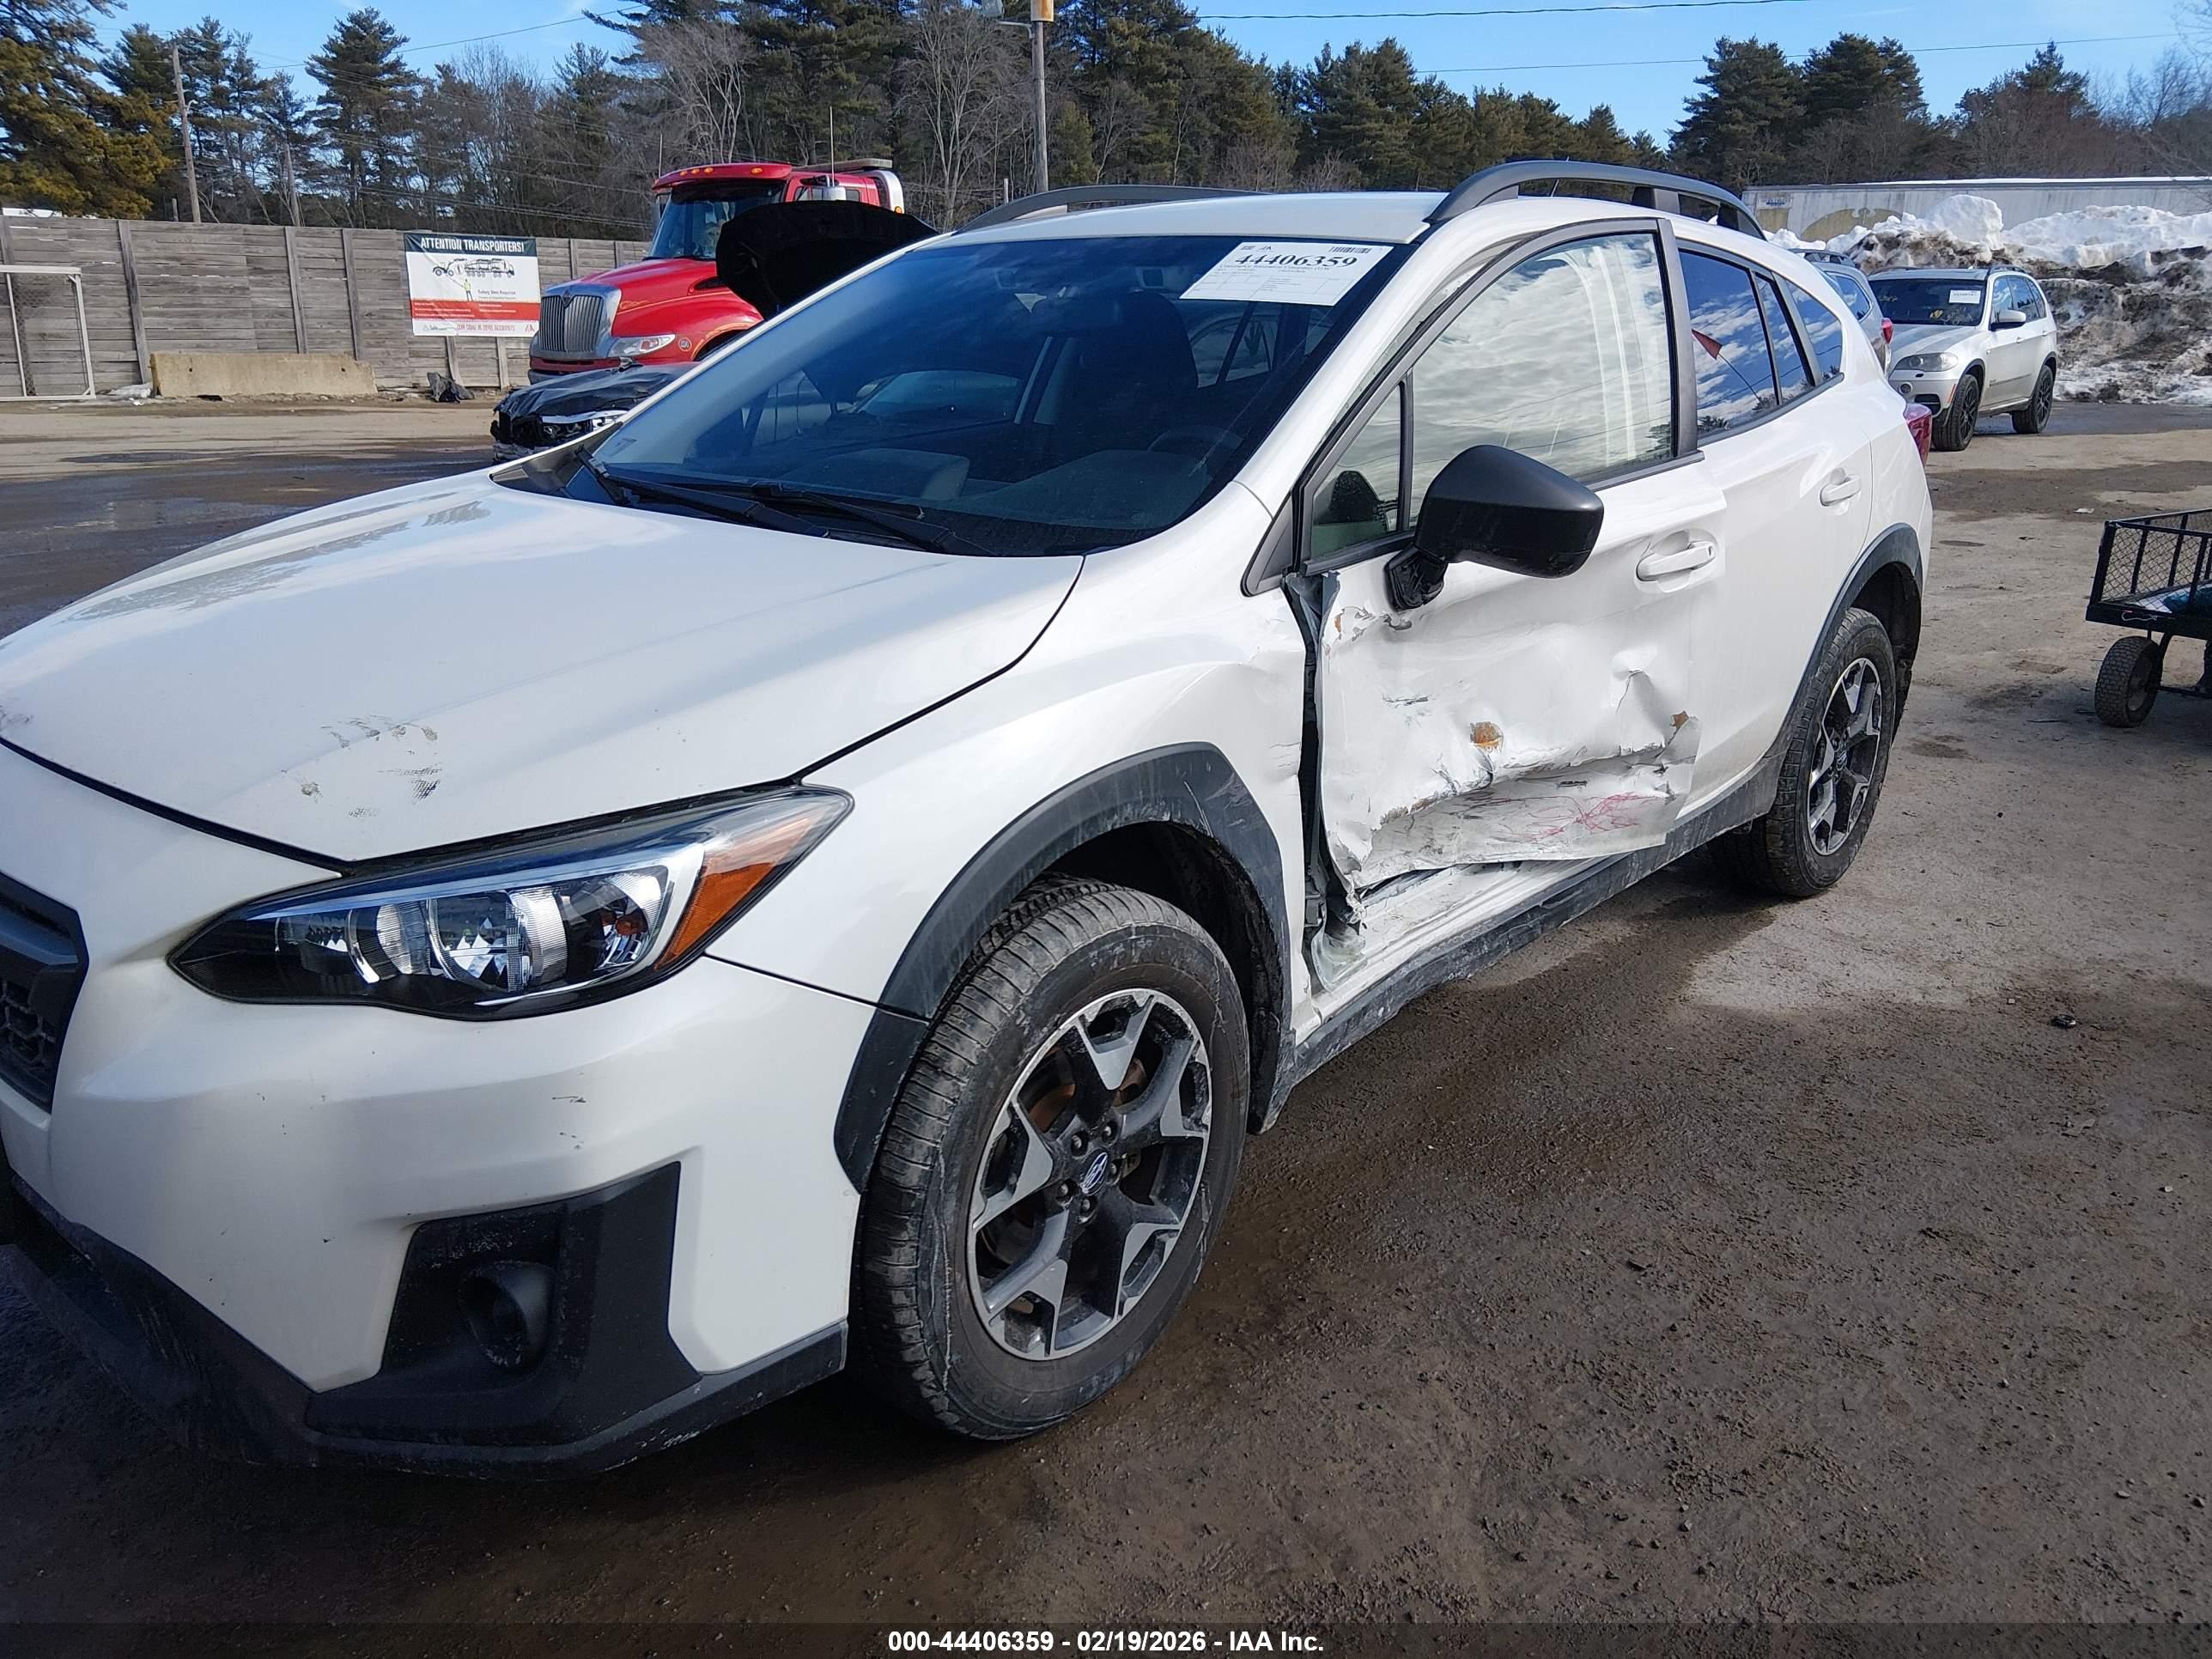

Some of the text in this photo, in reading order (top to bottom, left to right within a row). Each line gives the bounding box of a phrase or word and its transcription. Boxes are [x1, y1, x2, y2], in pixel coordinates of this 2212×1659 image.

[421, 237, 525, 252] ATTENTION TRANSPORTERS!
[1235, 254, 1358, 268] 44406359
